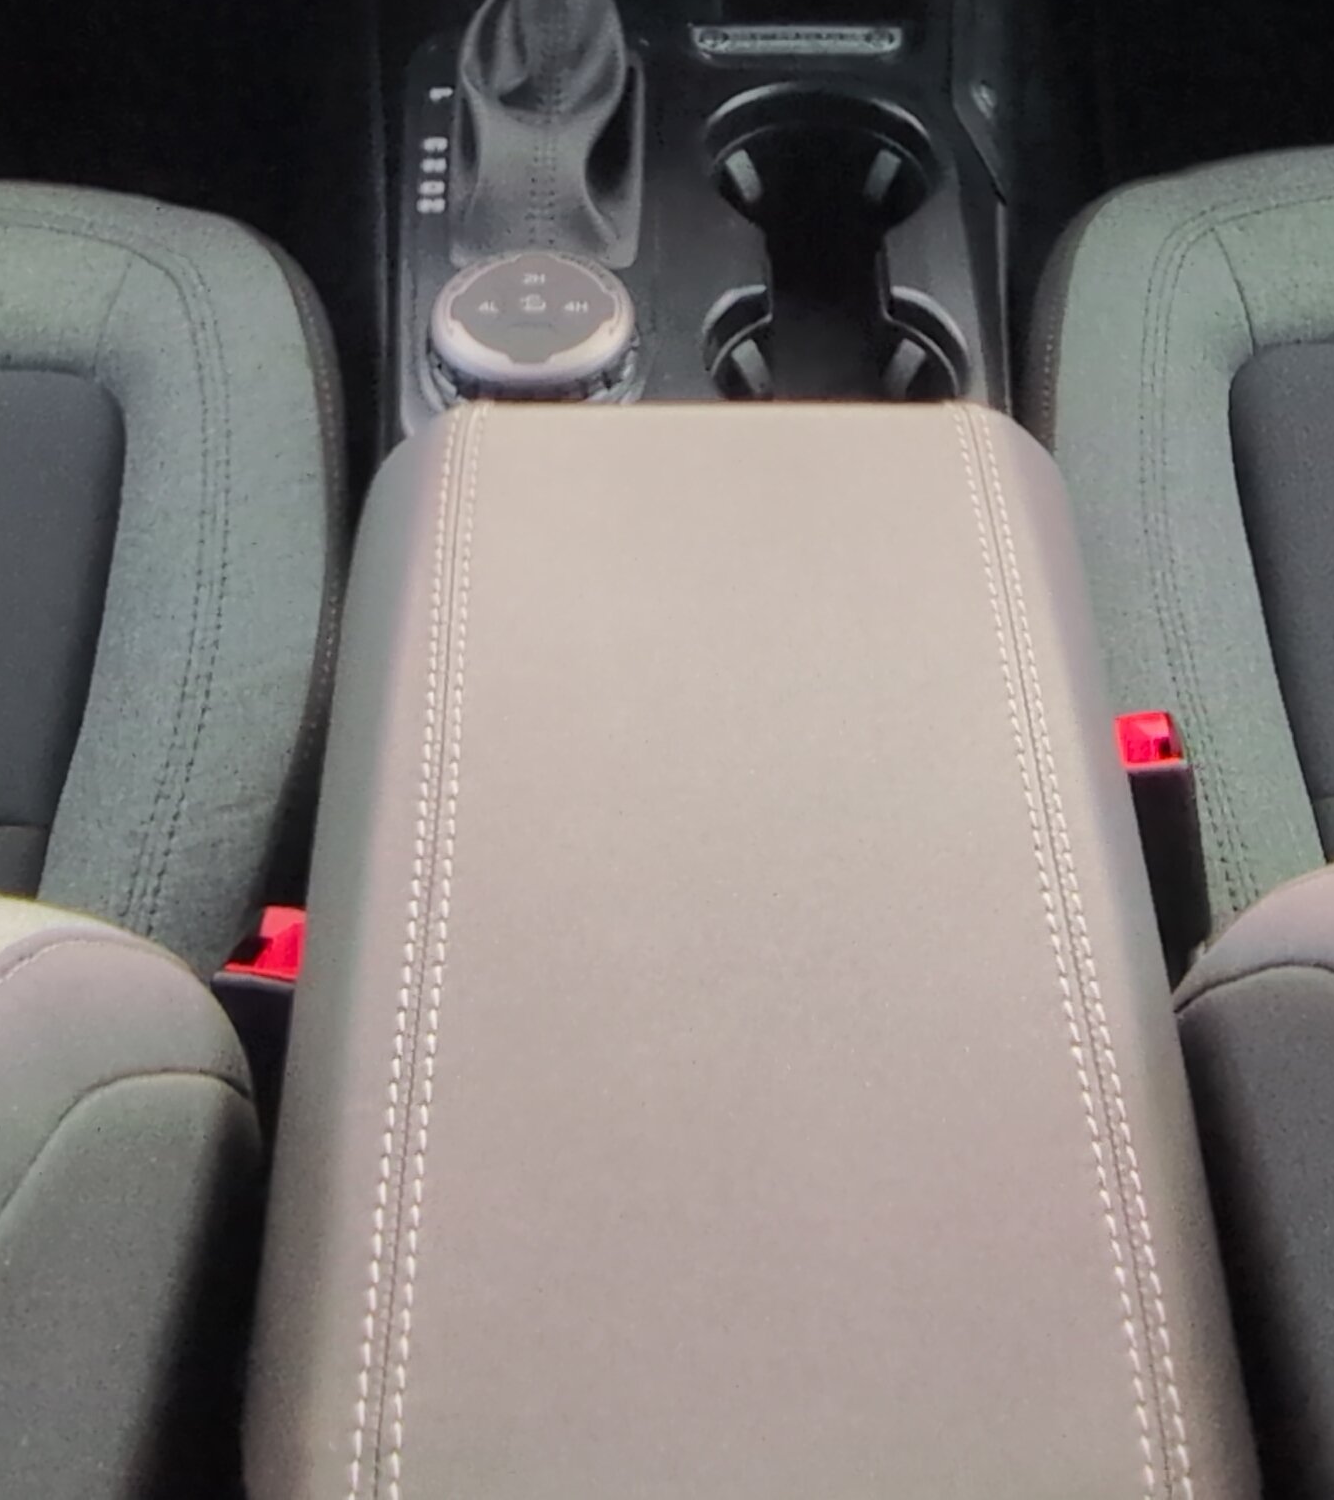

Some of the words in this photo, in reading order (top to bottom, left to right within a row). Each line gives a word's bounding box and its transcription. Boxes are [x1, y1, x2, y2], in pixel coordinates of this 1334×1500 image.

[522, 272, 546, 284] 2H
[478, 301, 499, 313] 4L
[563, 301, 589, 313] 4H
